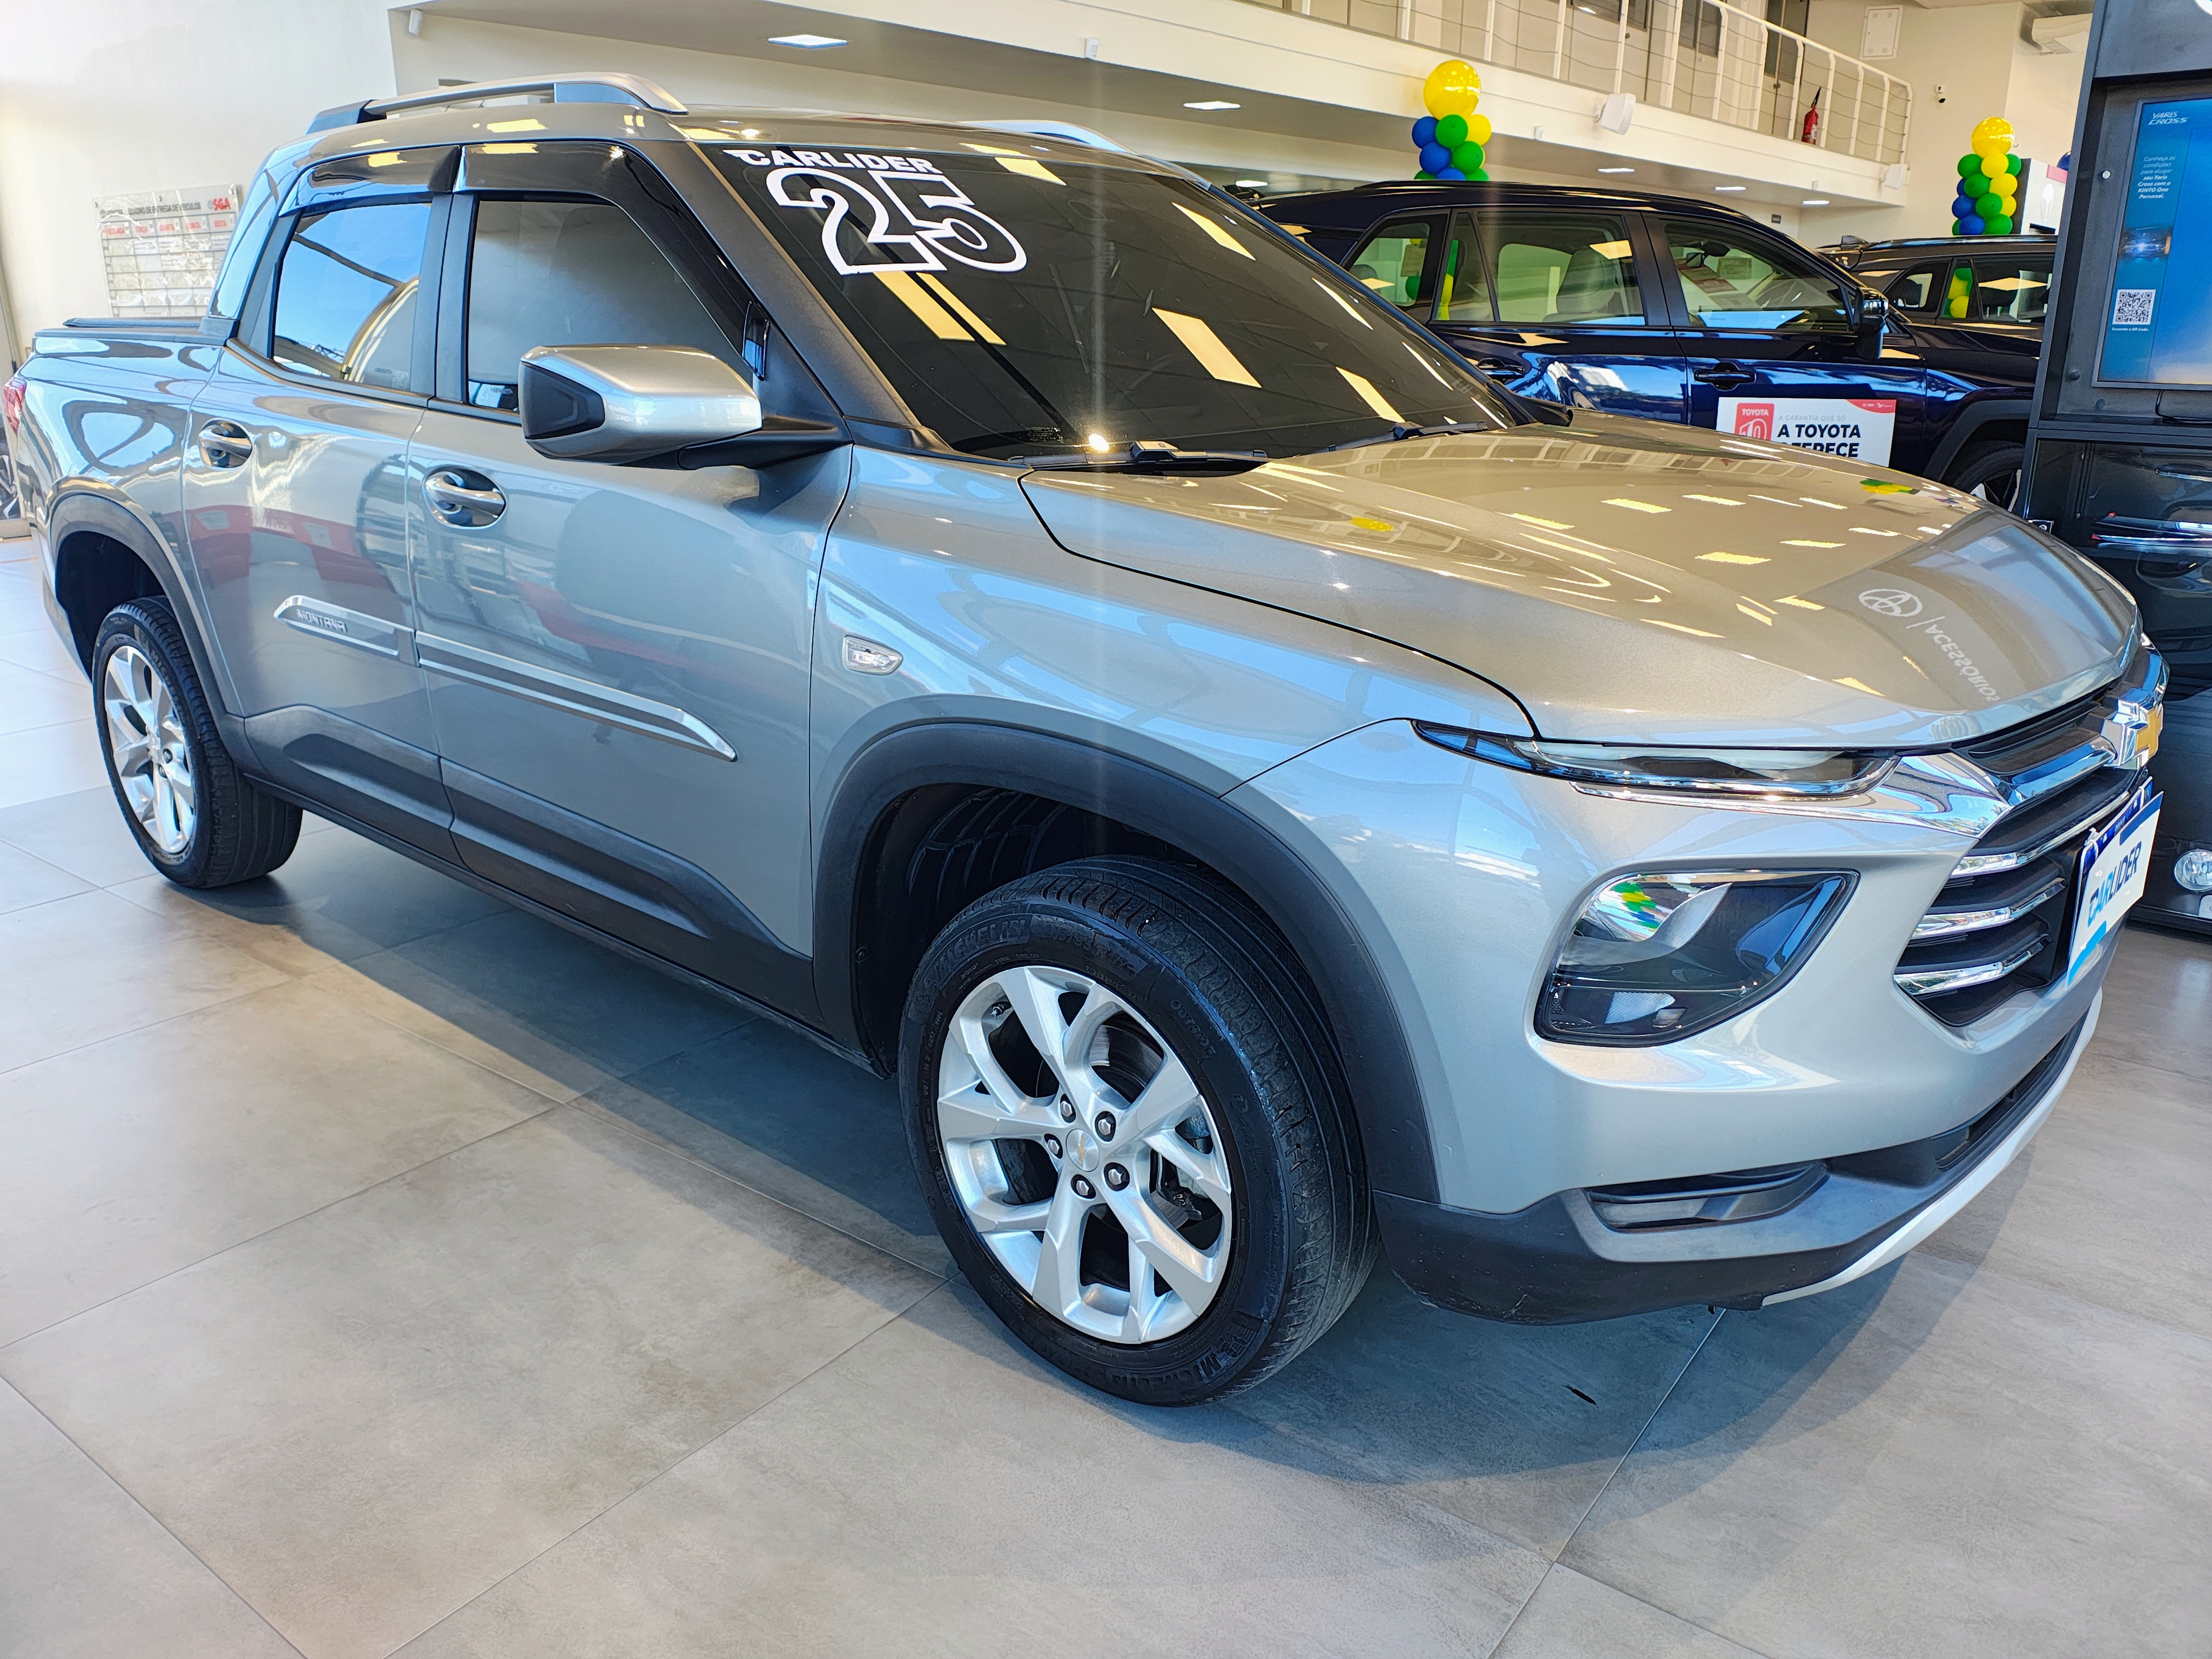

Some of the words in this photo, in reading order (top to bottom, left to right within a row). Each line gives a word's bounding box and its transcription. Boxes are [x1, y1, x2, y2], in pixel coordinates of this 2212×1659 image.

[2148, 117, 2188, 125] CROSS
[2153, 111, 2178, 119] YARIS
[722, 149, 944, 174] CARLIDER
[213, 197, 231, 211] SGA
[766, 167, 1027, 276] 25
[1742, 408, 1769, 416] TOYOTA
[1777, 424, 1790, 438] A
[1795, 424, 1862, 438] TOYOTA
[1783, 442, 1860, 458] RECE
[296, 610, 348, 633] MONTANA
[2087, 840, 2142, 928] CARLIDER
[933, 919, 1027, 981] MICHELIN
[1170, 999, 1217, 1055] OUTSIDE
